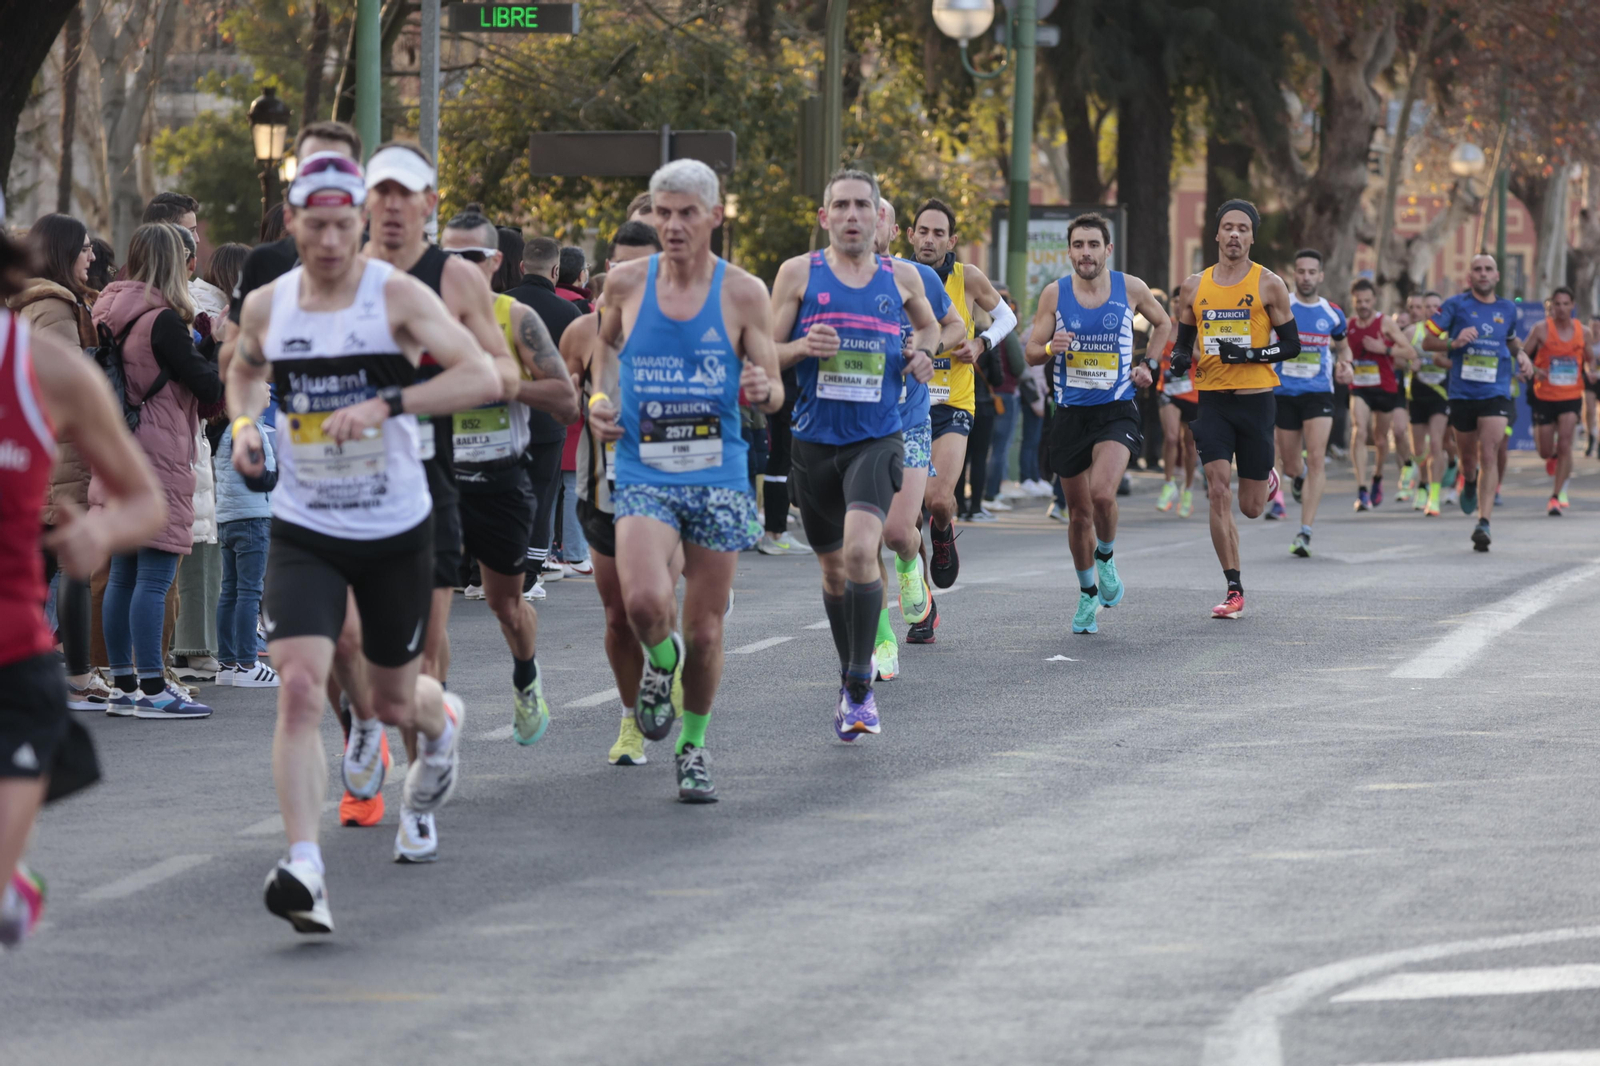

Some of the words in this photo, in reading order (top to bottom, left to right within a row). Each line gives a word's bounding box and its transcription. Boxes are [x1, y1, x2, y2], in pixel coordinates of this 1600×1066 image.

[480, 6, 539, 28] LIBRE
[843, 338, 880, 350] ZURICH
[1082, 343, 1113, 351] ZURICH
[844, 360, 863, 370] 938
[1075, 369, 1107, 378] ITURRASPE
[288, 369, 368, 394] kiwami
[823, 374, 862, 385] CHERMAN
[929, 387, 950, 395] ARATON
[311, 392, 368, 412] ZURICH
[664, 402, 711, 415] ZURICH
[461, 418, 481, 430] 852
[665, 425, 694, 439] 2577
[456, 436, 490, 447] BALILLA
[672, 445, 690, 454] FINI
